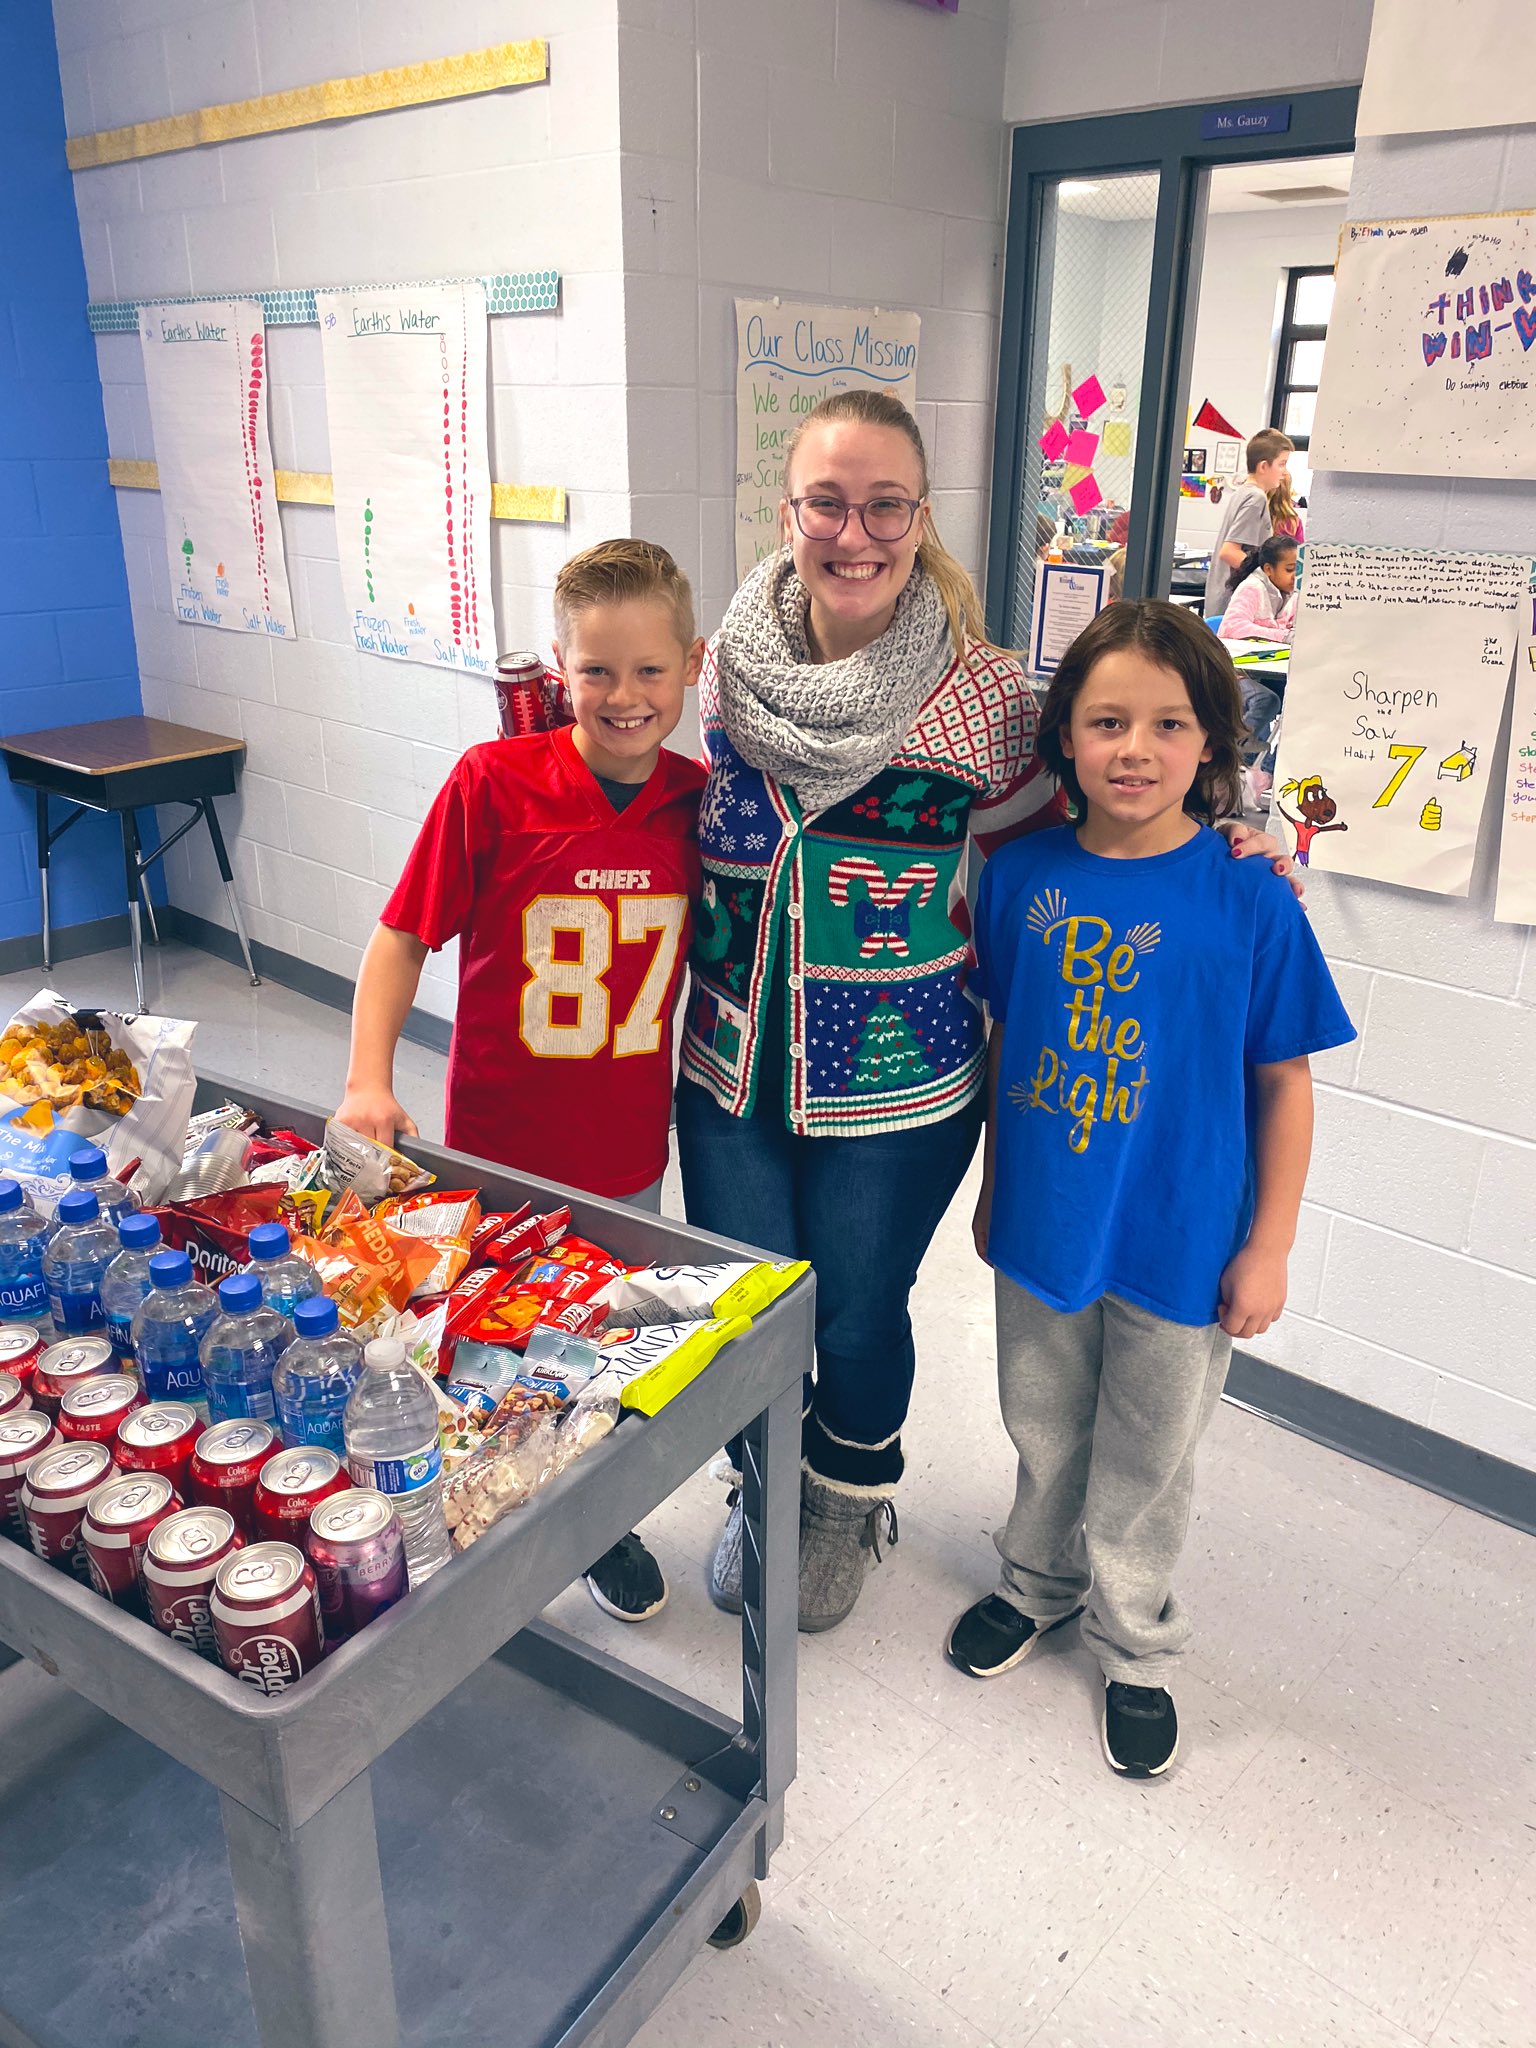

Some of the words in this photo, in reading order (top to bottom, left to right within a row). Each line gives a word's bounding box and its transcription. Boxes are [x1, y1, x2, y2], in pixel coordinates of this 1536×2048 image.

[1237, 114, 1270, 127] Gauzy
[196, 320, 227, 340] Water
[399, 308, 440, 331] Water
[747, 315, 783, 359] Our
[794, 320, 844, 364] Class
[851, 326, 916, 368] Mission
[753, 382, 779, 415] We
[753, 496, 773, 524] to
[356, 610, 391, 634] Frozen
[354, 625, 379, 651] Fresh
[378, 634, 408, 656] Water
[433, 638, 457, 664] Salt
[462, 648, 490, 671] Water
[1344, 671, 1438, 713] Sharpen
[1352, 715, 1396, 740] Saw
[1344, 747, 1375, 761] Habit
[1372, 744, 1427, 808] 7
[574, 869, 651, 890] CHIEFS
[1043, 915, 1140, 993] Be
[519, 894, 689, 1059] 87
[1063, 985, 1145, 1060] the
[1029, 1046, 1150, 1154] Light
[76, 1423, 101, 1432] TASTE
